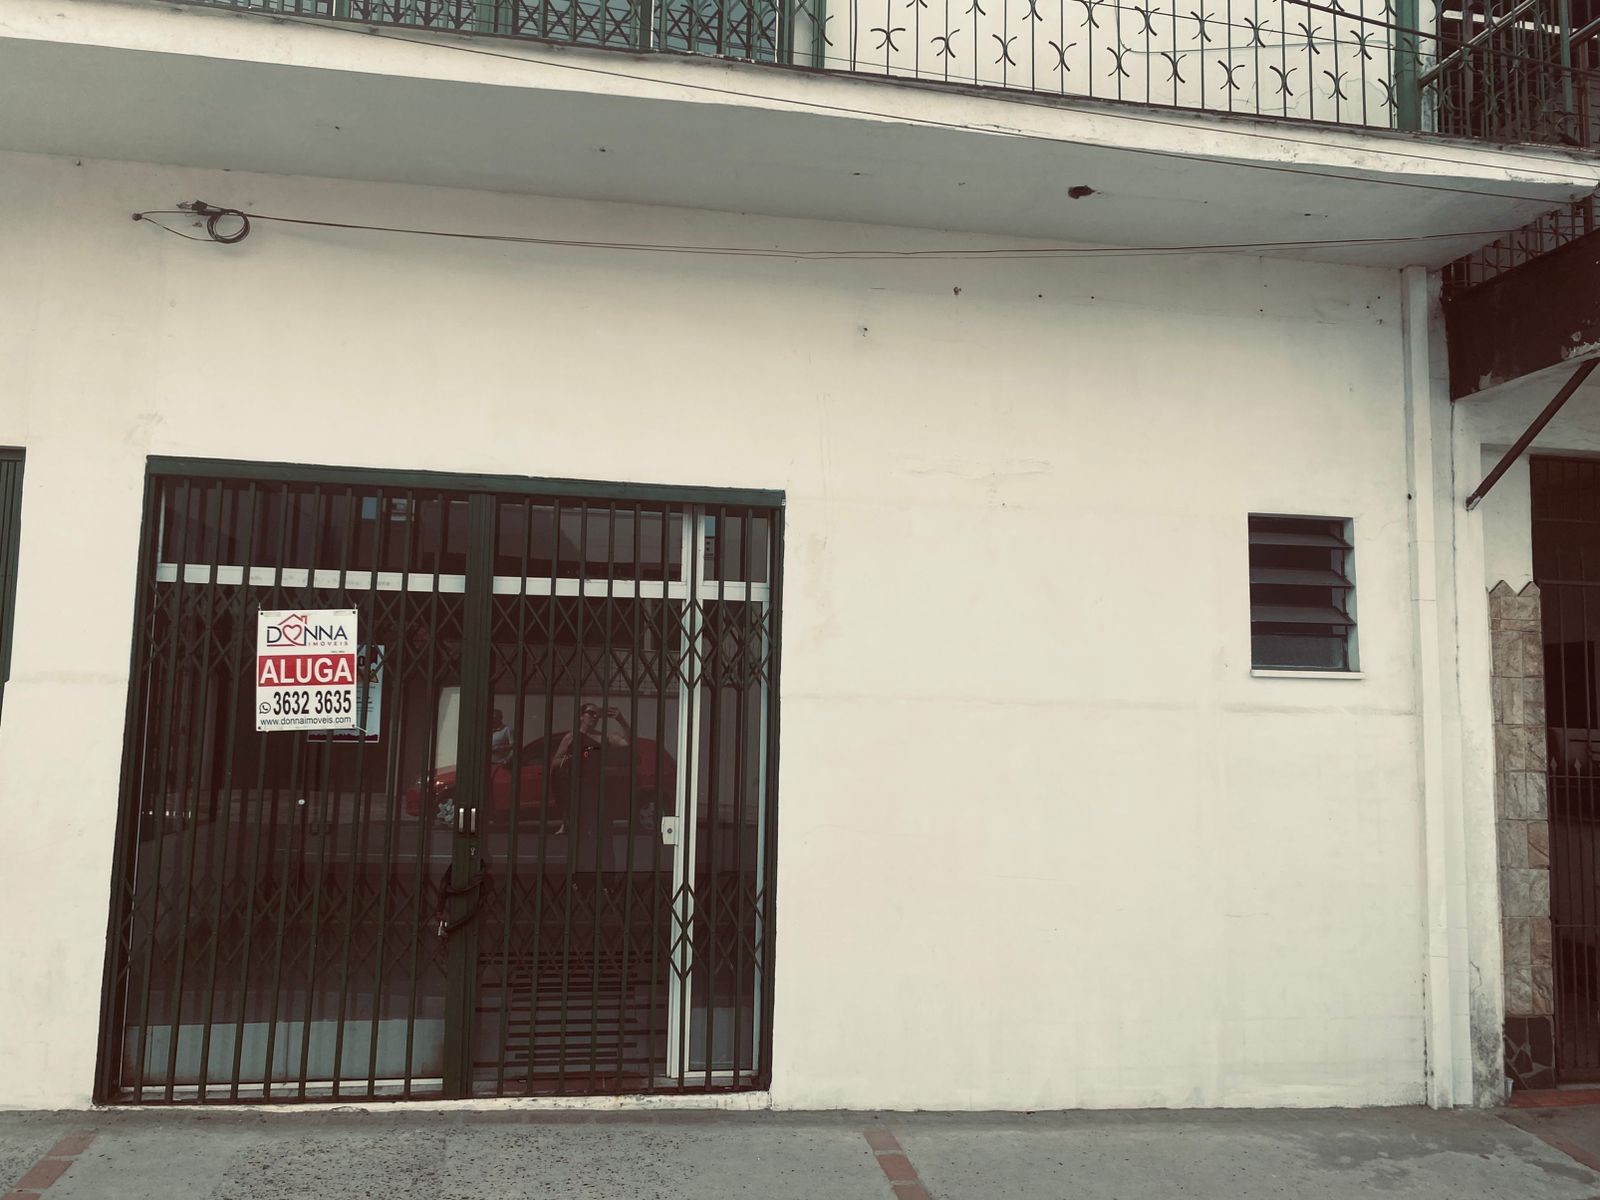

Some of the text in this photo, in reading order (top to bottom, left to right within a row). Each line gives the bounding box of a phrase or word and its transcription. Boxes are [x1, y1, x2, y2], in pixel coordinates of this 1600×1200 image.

[259, 657, 353, 684] ALUGA
[273, 691, 310, 715] 3632
[315, 690, 352, 714] 3635
[260, 715, 352, 726] www.donnaimoveis.com
